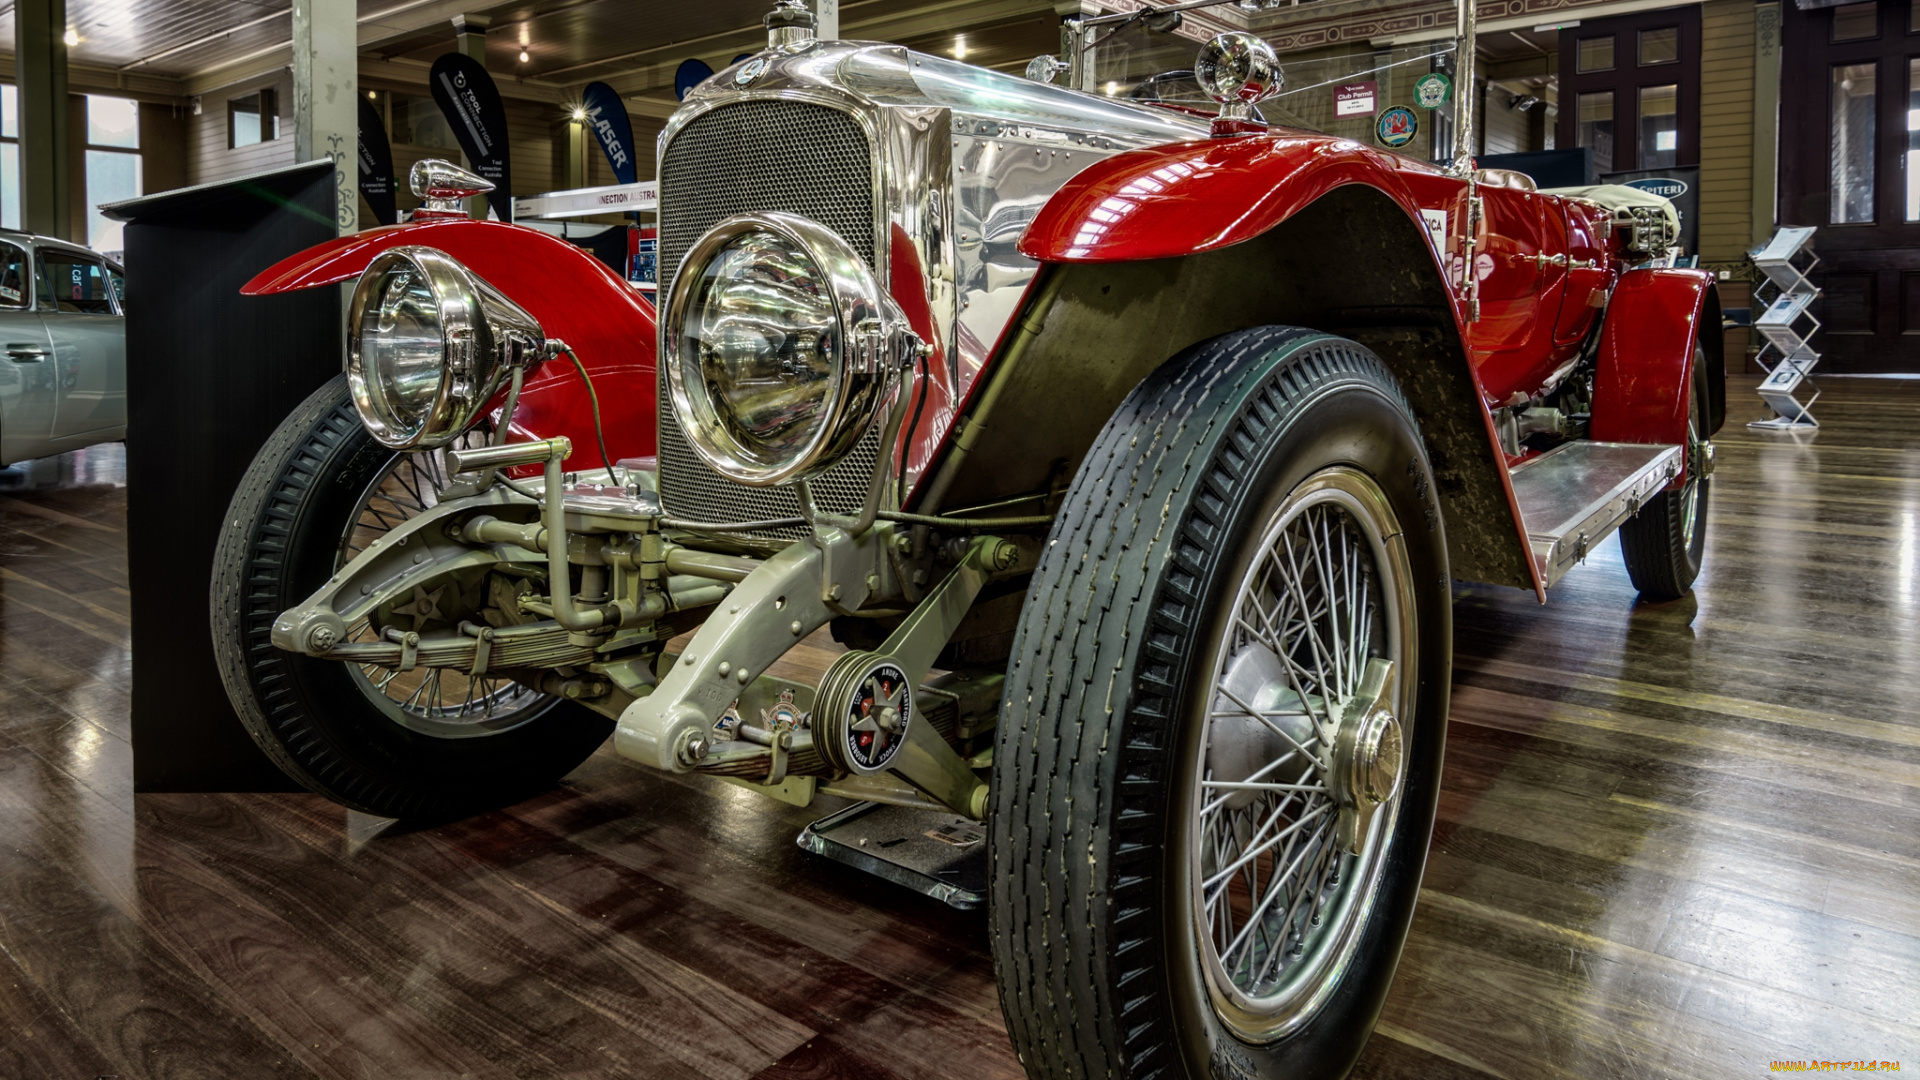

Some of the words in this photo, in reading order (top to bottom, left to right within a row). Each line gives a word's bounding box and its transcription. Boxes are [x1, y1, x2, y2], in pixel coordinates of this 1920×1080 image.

[467, 88, 481, 114] TOOL
[1353, 89, 1373, 98] Permit
[460, 91, 493, 147] CONNECTION
[590, 106, 627, 169] LASER
[358, 140, 376, 166] CTION
[882, 668, 898, 680] ANDRE
[901, 687, 910, 727] HARTFORD
[849, 734, 868, 764] ABSORBER
[880, 743, 896, 761] SHOCK
